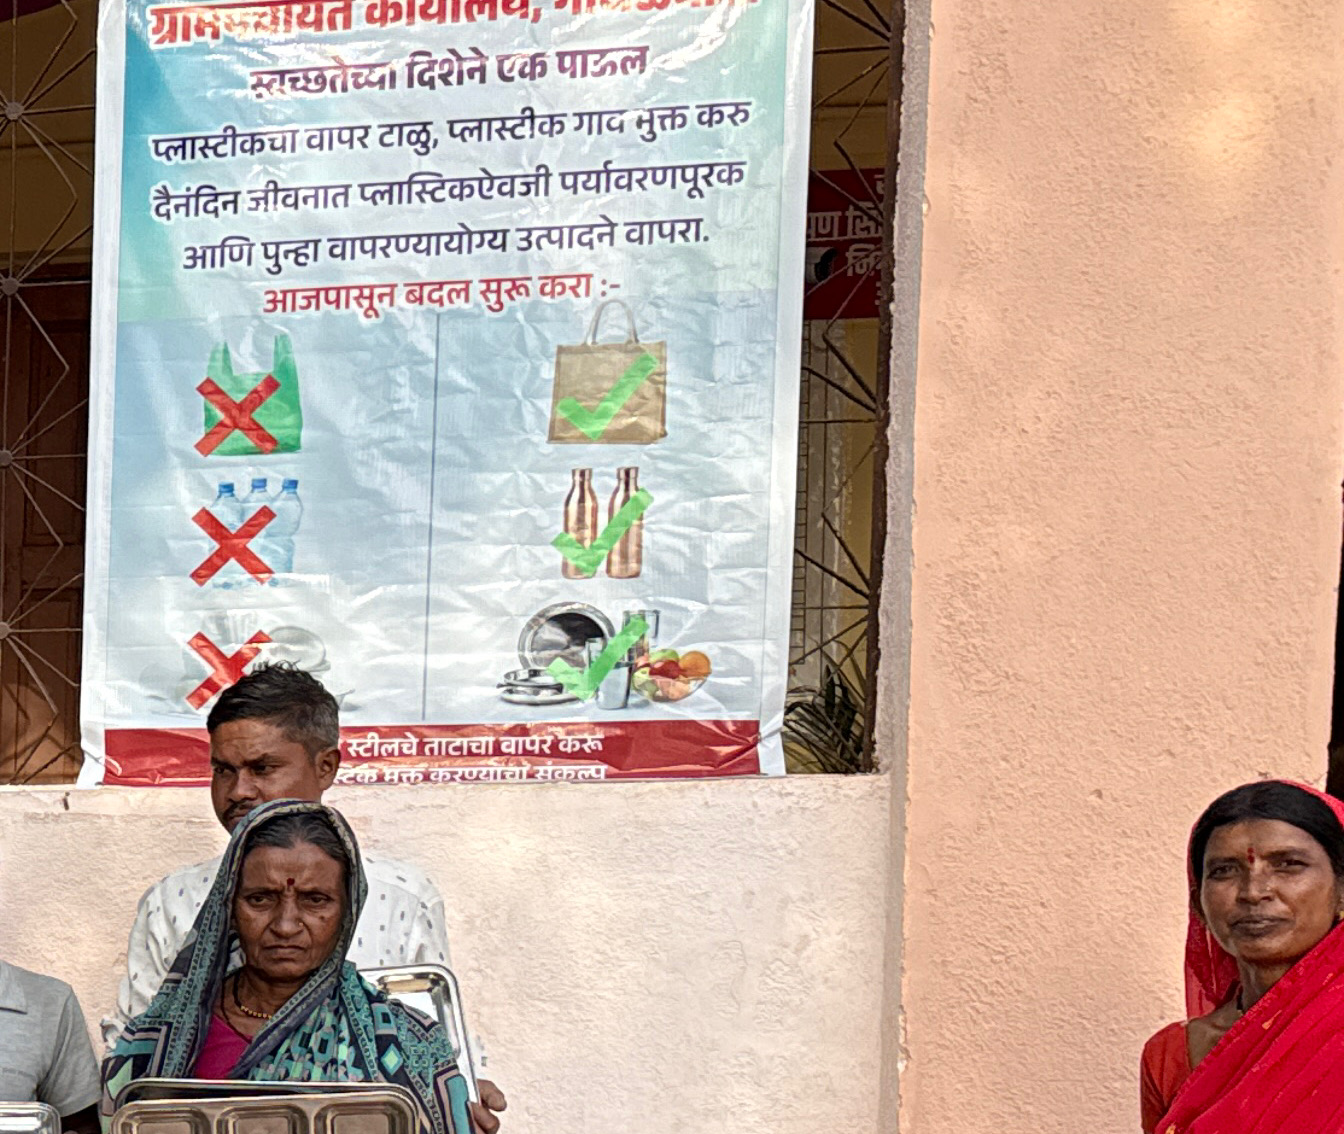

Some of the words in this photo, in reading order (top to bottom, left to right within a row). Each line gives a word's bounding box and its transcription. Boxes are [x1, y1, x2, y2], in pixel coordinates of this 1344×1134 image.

[406, 47, 489, 89] दिशेने
[496, 52, 550, 82] एक
[556, 45, 650, 79] पाऊल
[151, 125, 300, 161] प्लास्टीकचा
[305, 125, 372, 151] वापर
[378, 121, 440, 156] टाळु,
[447, 107, 568, 143] प्लास्टीक
[633, 105, 690, 143] मुक्त
[153, 184, 242, 222] दैनंदिन
[247, 180, 353, 213] जीवनात
[358, 163, 553, 206] प्लास्टिकऐवजी
[559, 160, 748, 199] पर्यावरणपूरक
[182, 236, 256, 270] आणि
[261, 239, 320, 276] पुन्हा
[327, 223, 511, 262] वापरण्यायोग्य
[516, 215, 619, 253] उत्पादने
[624, 216, 710, 247] वापरा.
[263, 283, 398, 319] आजपासून
[404, 280, 473, 309] बदल
[479, 276, 532, 313] सुरू
[537, 274, 593, 304] करा
[347, 732, 419, 758] स्टीलचे
[499, 735, 553, 755] वापर
[557, 733, 605, 754] करू
[383, 765, 424, 783] मक्त
